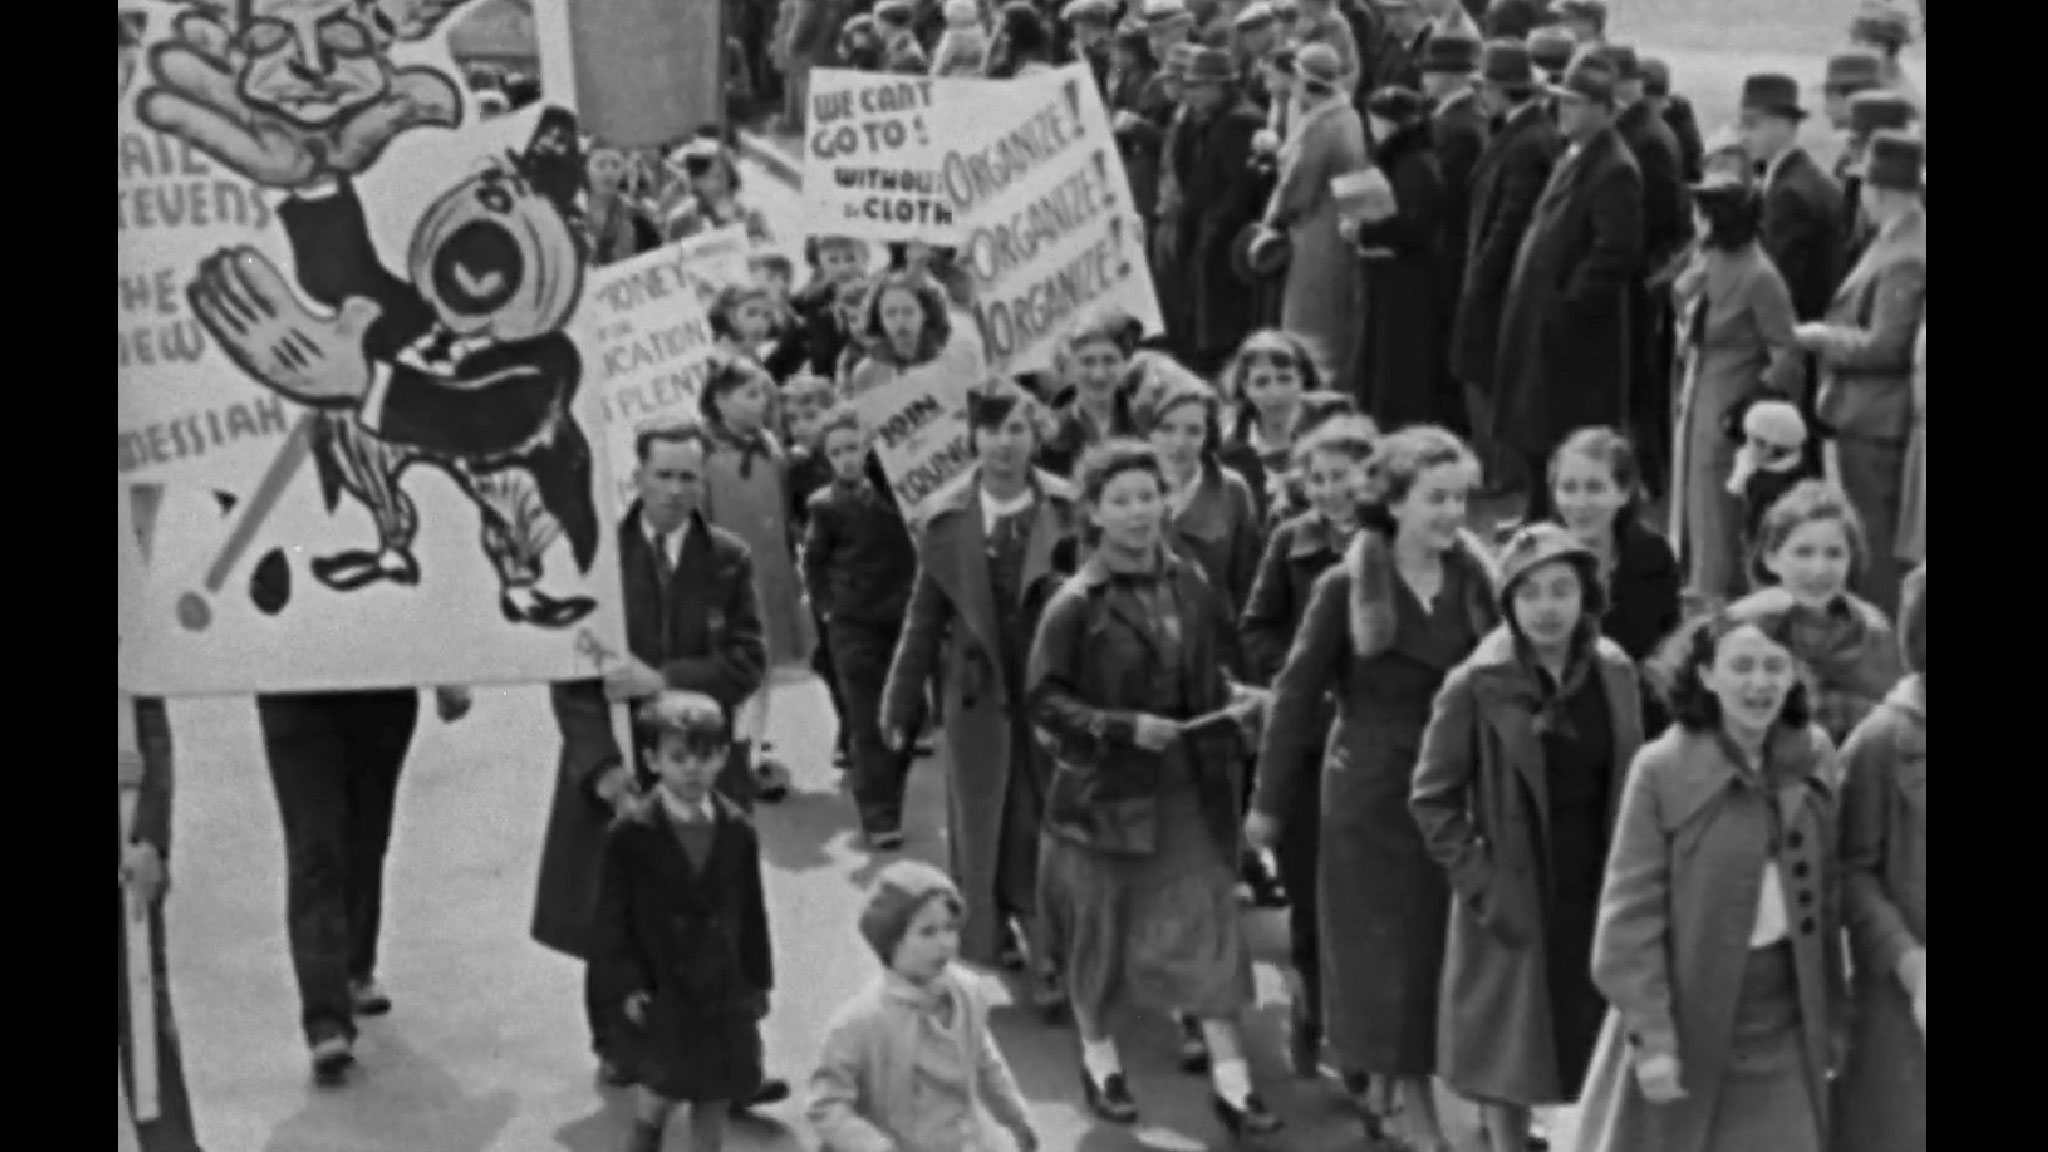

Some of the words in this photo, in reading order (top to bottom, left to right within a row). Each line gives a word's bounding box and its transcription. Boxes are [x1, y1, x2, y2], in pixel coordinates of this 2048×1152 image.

[812, 89, 853, 122] WE
[811, 124, 858, 159] GO
[862, 119, 907, 154] TO
[943, 79, 1085, 210] ORGANIZE!
[834, 166, 943, 194] WITHOU
[969, 149, 1116, 283] ORGANIZE!
[989, 216, 1132, 356] ORGANIZE!
[879, 393, 944, 449] JOIN
